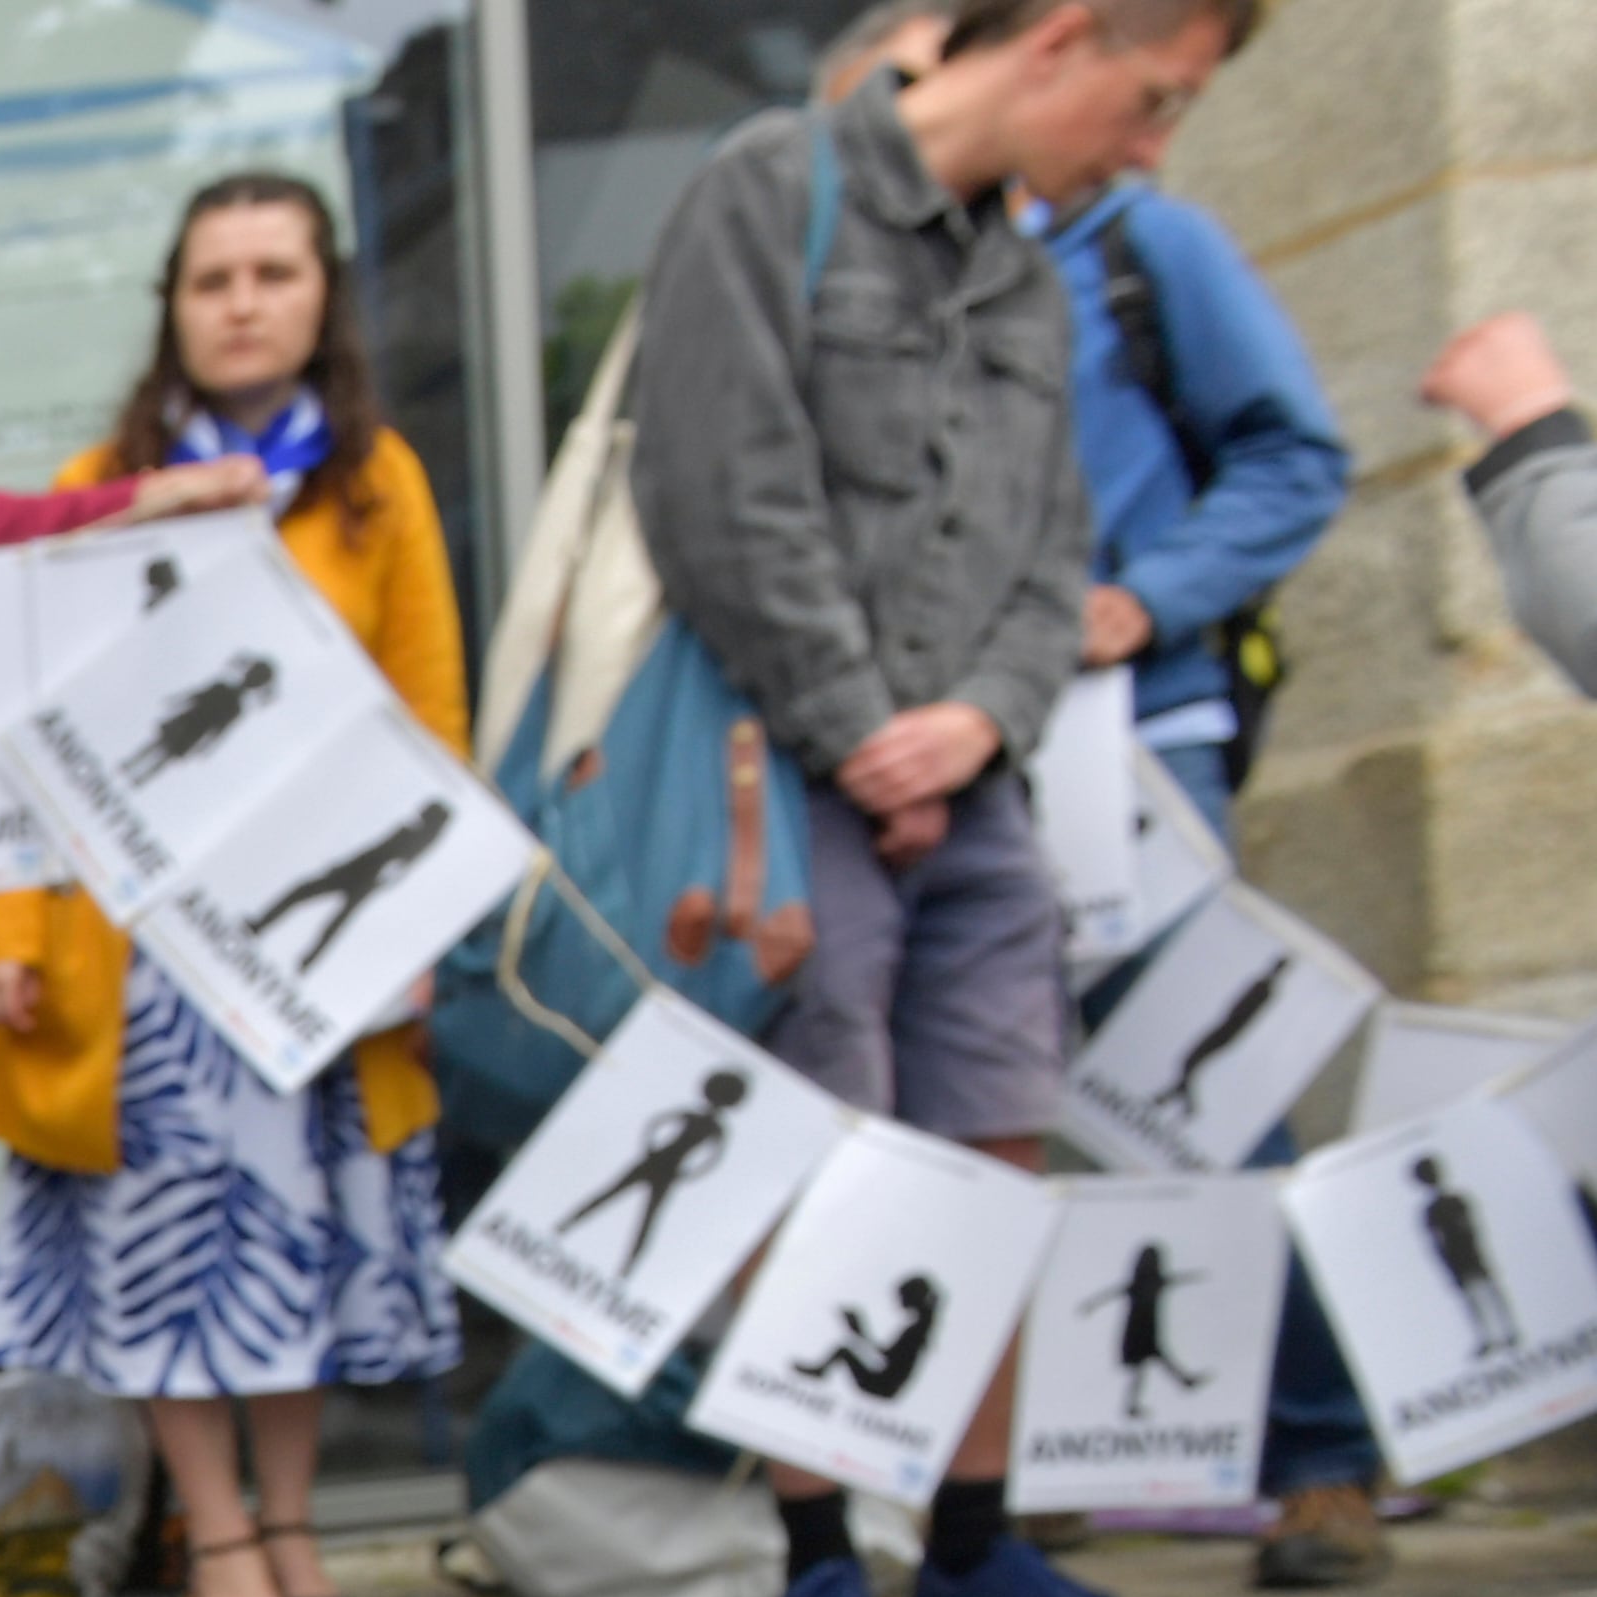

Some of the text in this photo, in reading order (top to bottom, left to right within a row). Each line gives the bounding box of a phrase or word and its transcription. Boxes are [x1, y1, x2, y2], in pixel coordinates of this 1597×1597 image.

[33, 706, 178, 883] ANONYME
[171, 889, 341, 1050] ANONYME
[478, 1210, 670, 1340] ANONYME
[1027, 1421, 1245, 1471] ANONYME
